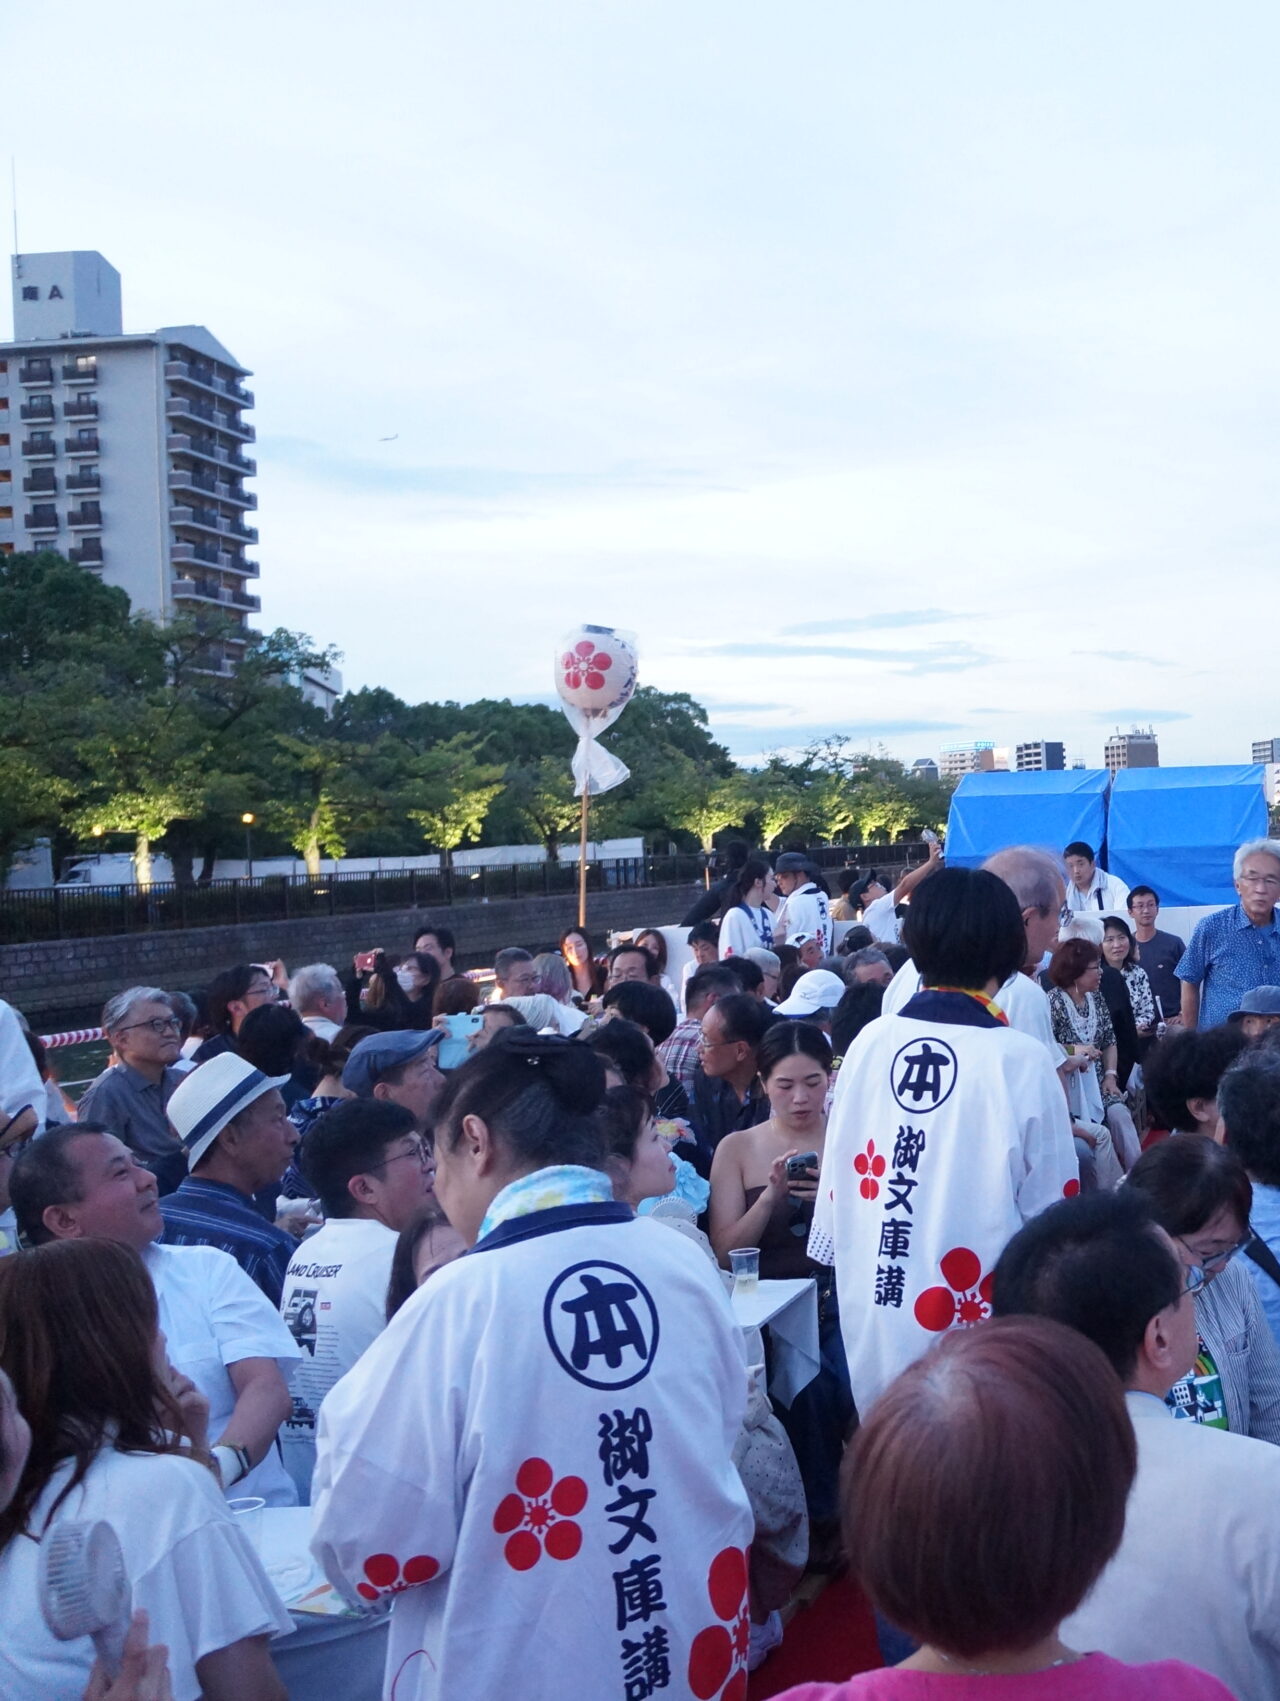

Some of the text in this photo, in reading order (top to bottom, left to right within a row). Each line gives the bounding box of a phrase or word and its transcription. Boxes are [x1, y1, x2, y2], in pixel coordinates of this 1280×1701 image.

[874, 1124, 927, 1309] 御文庫講
[597, 1406, 672, 1701] 御文庫講
